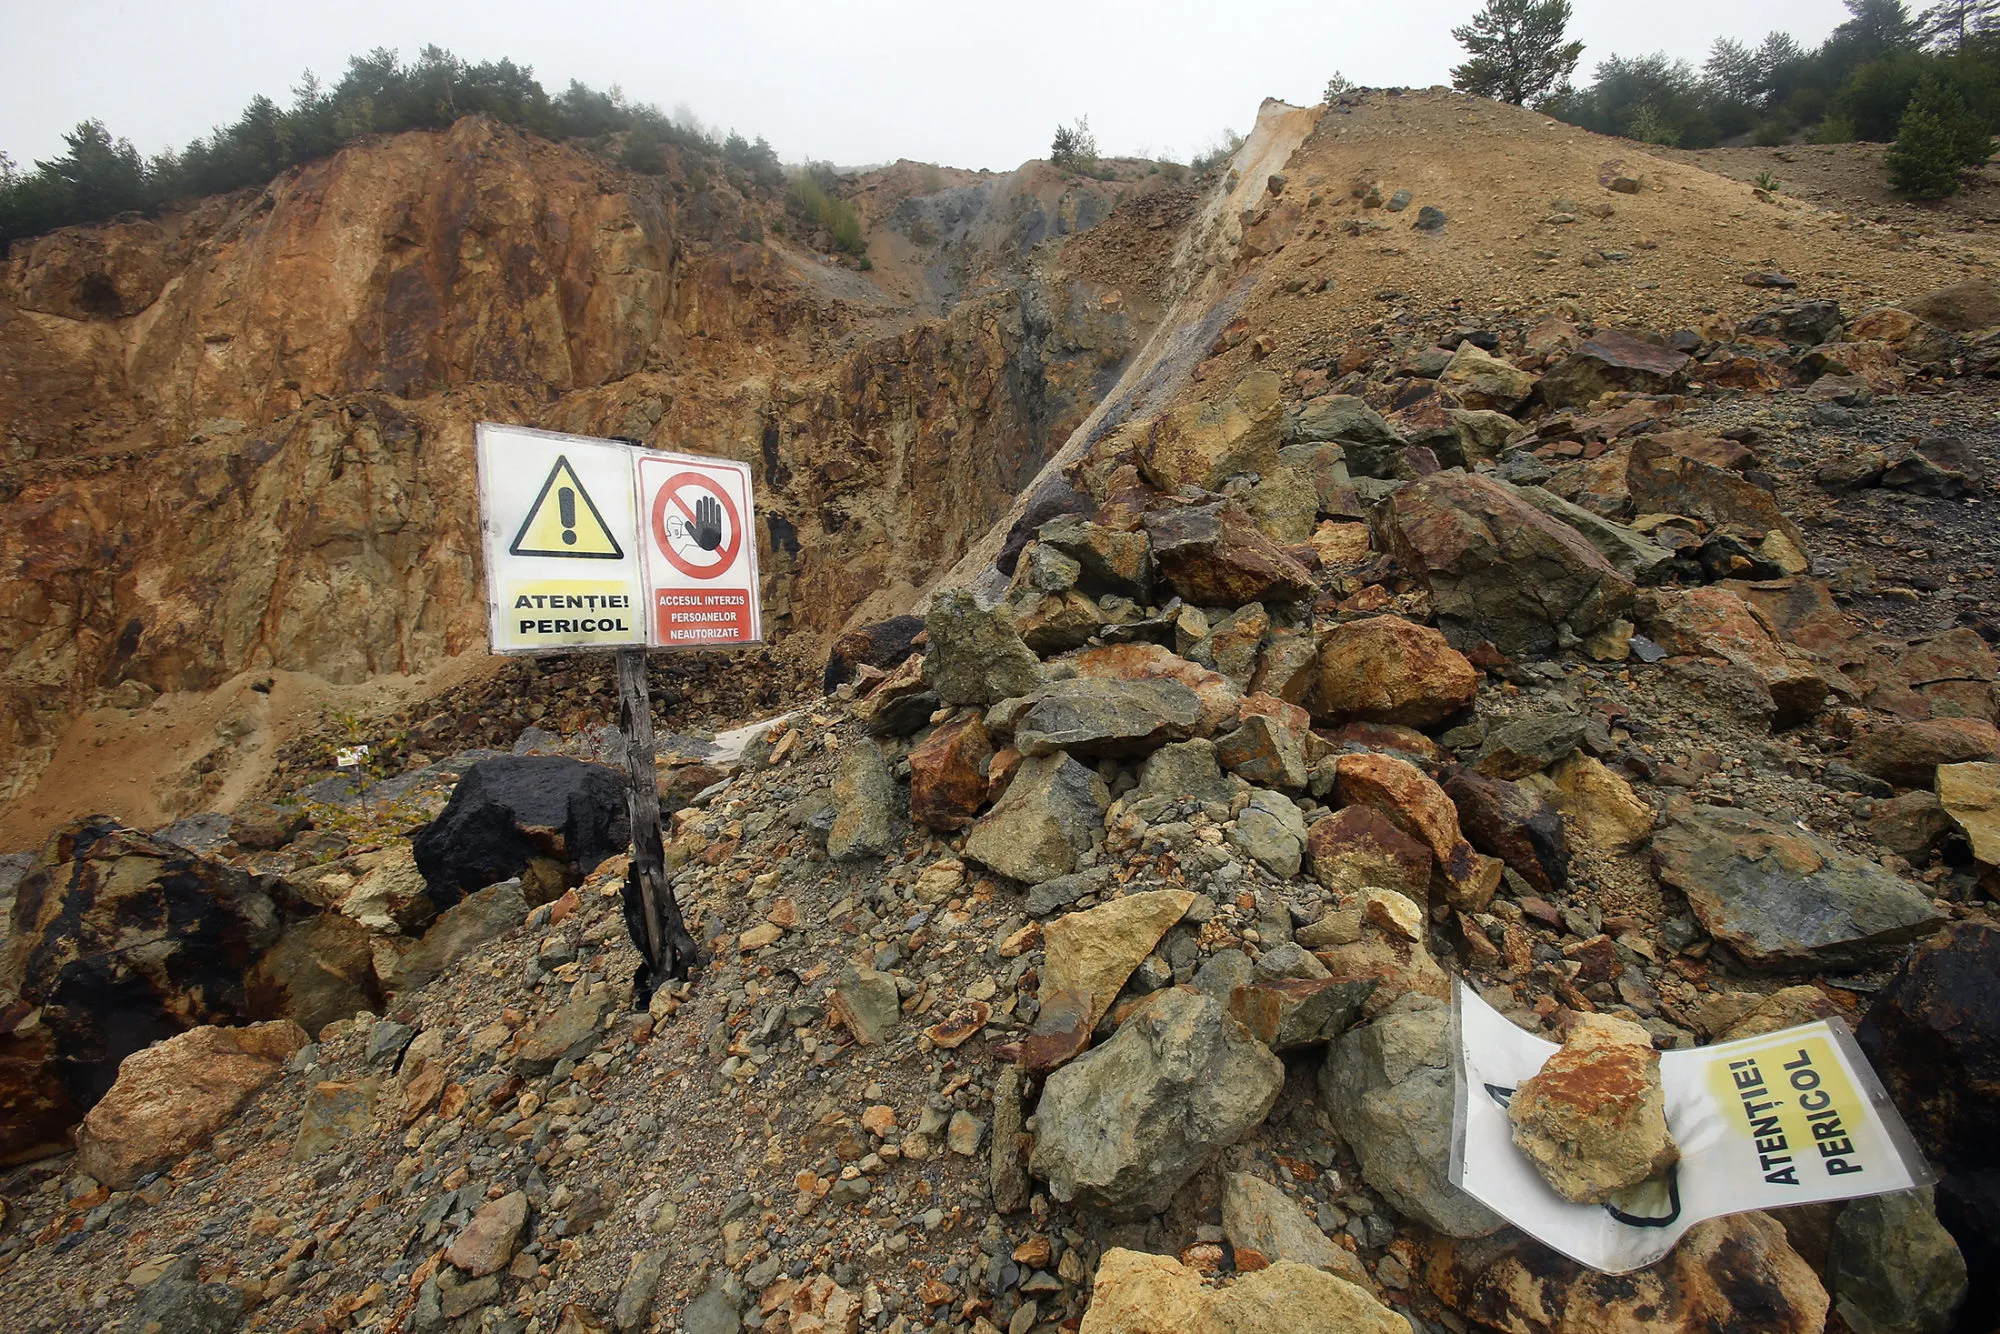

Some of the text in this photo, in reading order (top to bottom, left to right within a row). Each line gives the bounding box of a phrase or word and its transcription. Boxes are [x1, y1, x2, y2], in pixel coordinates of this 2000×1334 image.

[514, 595, 630, 613] ATENȚIE!
[660, 595, 745, 606] ACCESUL INTERZIS
[671, 611, 737, 623] PERSOANELOR
[520, 618, 629, 634] PERICOL
[670, 628, 739, 640] NEAUTORIZATE
[1783, 1049, 1863, 1176] PERICOL
[1729, 1058, 1800, 1185] ATENȚIE!
